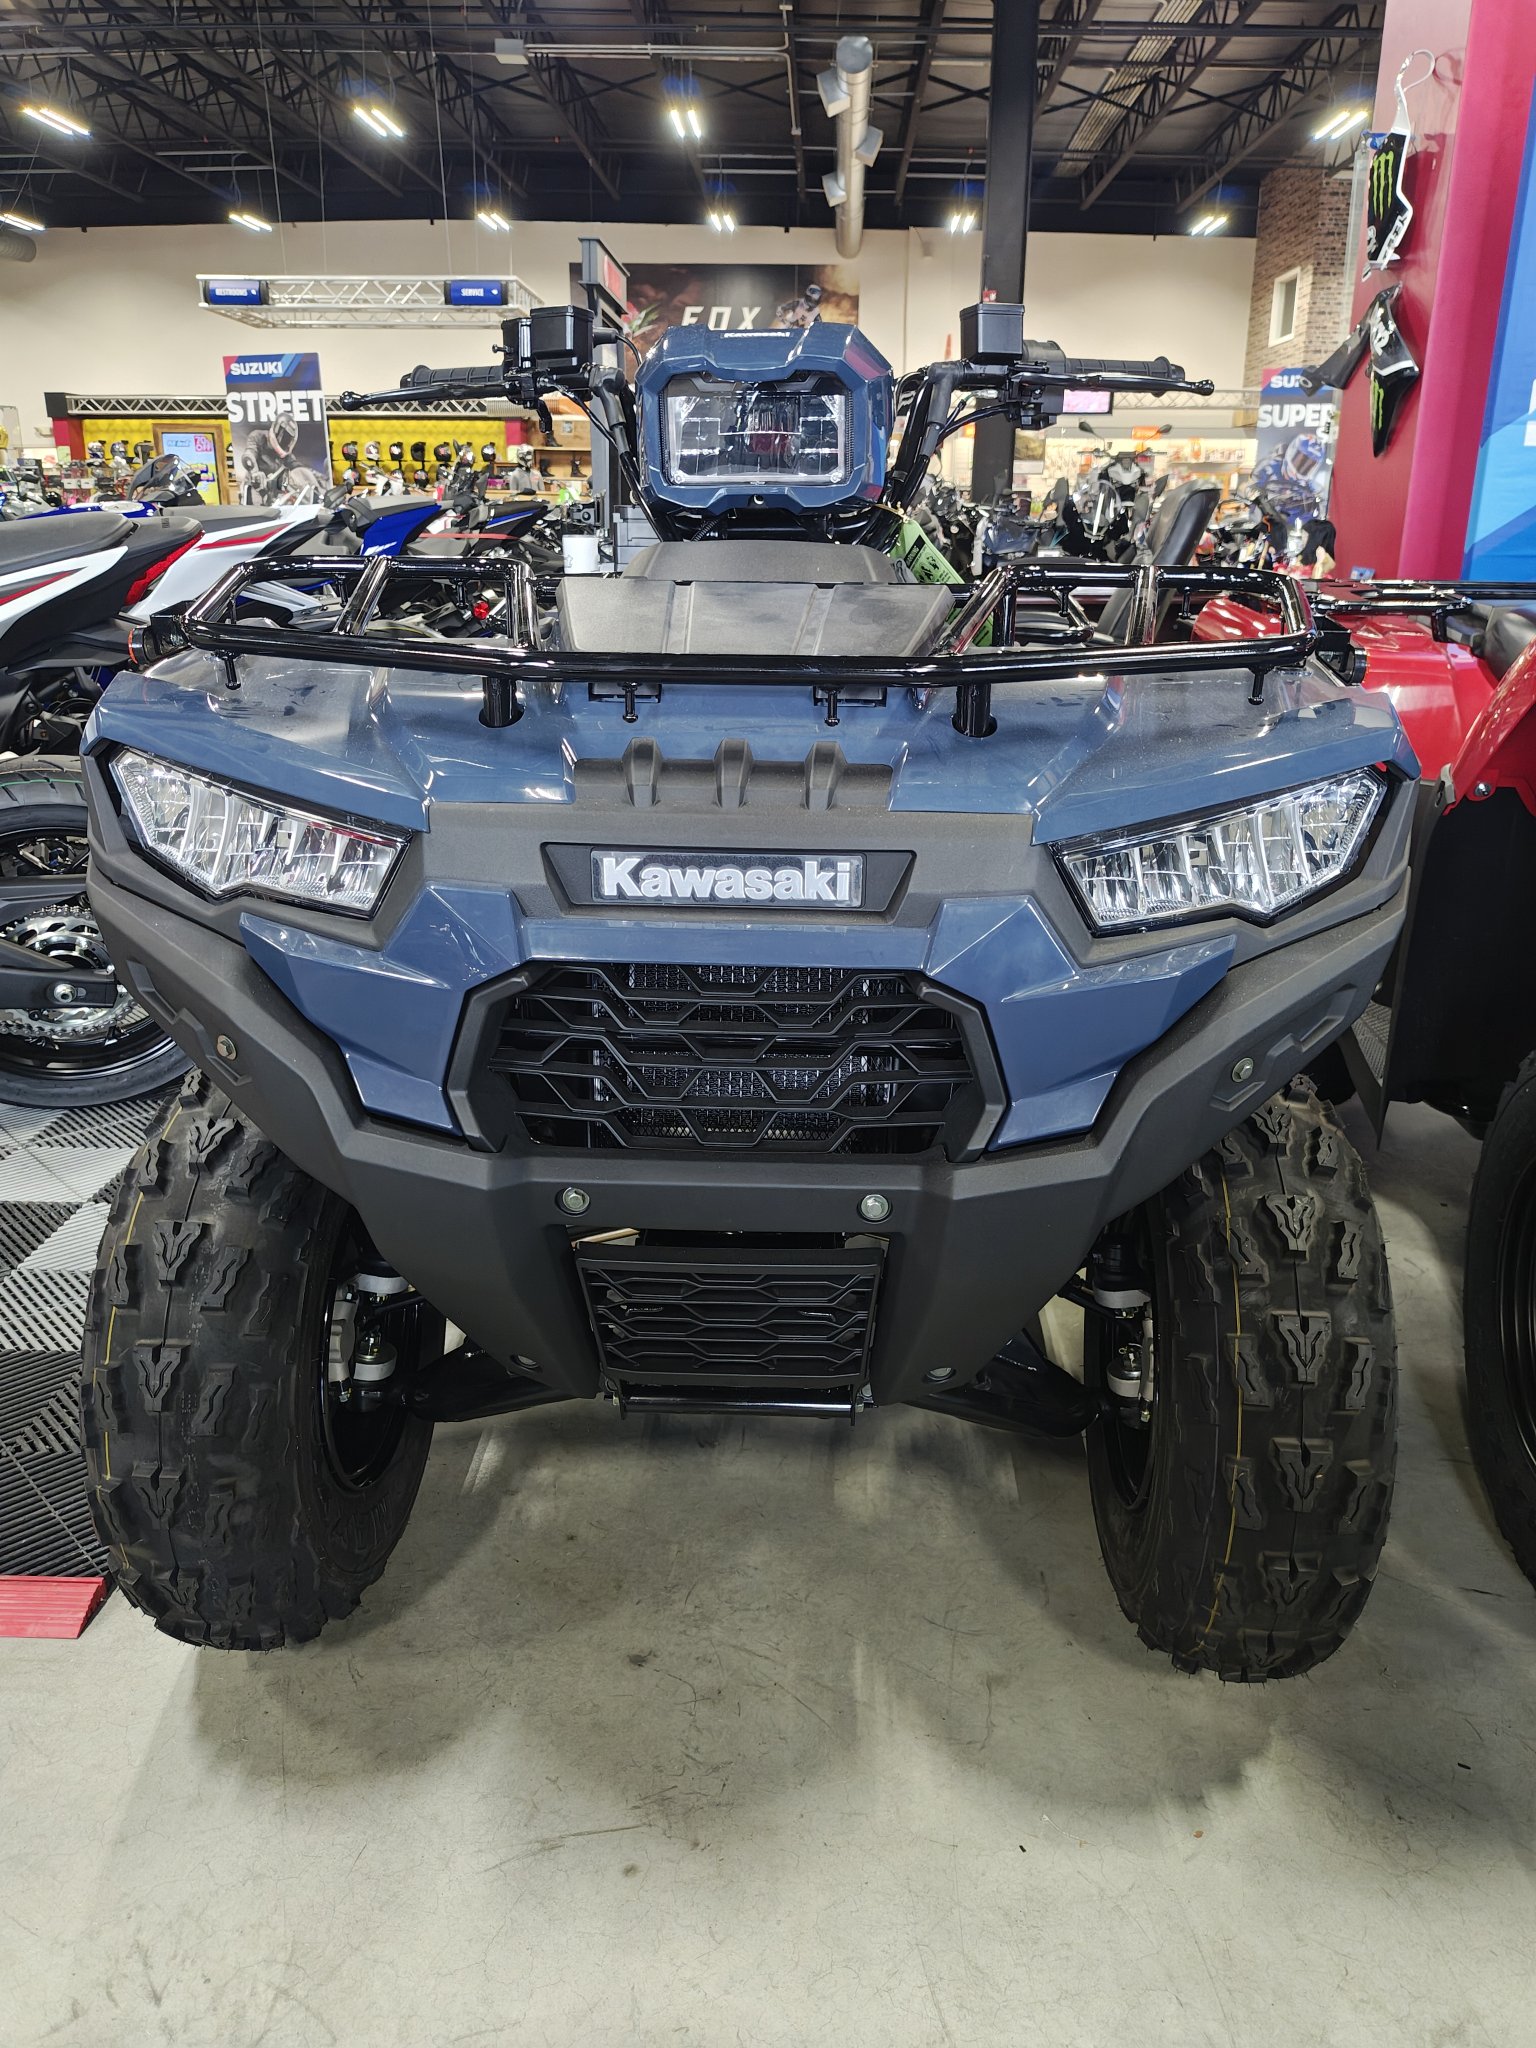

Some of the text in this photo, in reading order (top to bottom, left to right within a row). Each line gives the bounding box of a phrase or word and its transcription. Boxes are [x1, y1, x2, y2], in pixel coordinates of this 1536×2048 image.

[681, 306, 761, 331] FOX
[230, 361, 283, 376] SUZUKI
[225, 390, 323, 423] STREET
[1256, 403, 1336, 428] SUPER
[602, 857, 850, 901] Kawasaki
